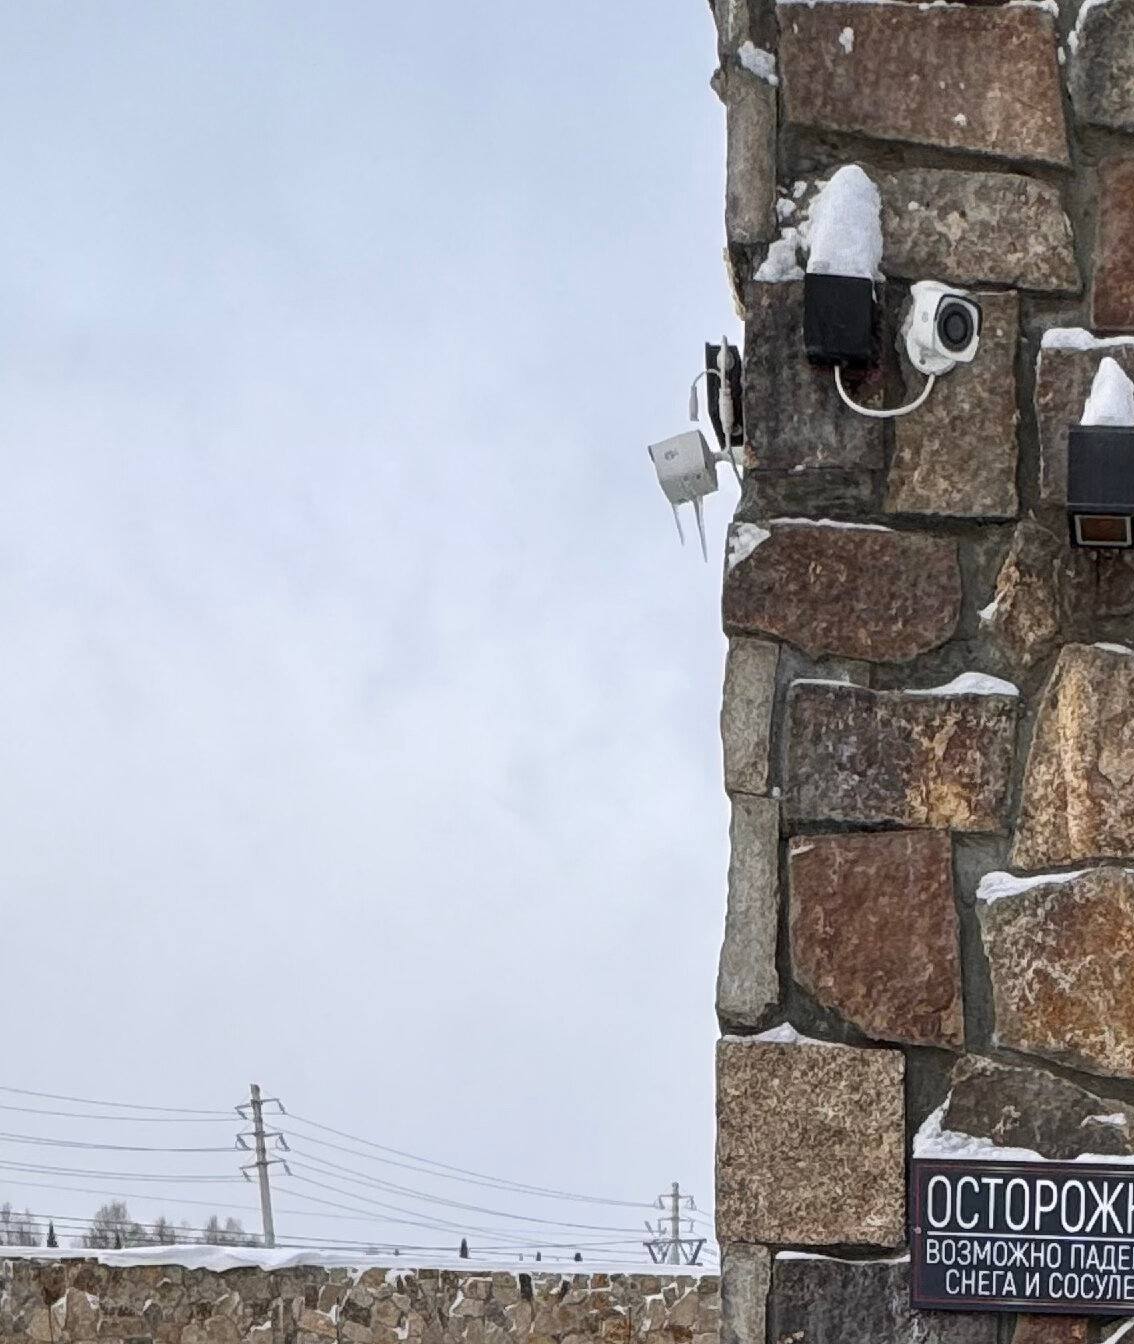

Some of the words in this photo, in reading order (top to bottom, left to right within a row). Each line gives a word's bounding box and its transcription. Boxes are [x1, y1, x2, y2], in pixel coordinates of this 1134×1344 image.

[926, 1238, 1062, 1268] ВОЗМОЖНО
[945, 1269, 1017, 1296] СНЕГА
[1025, 1272, 1040, 1297] И
